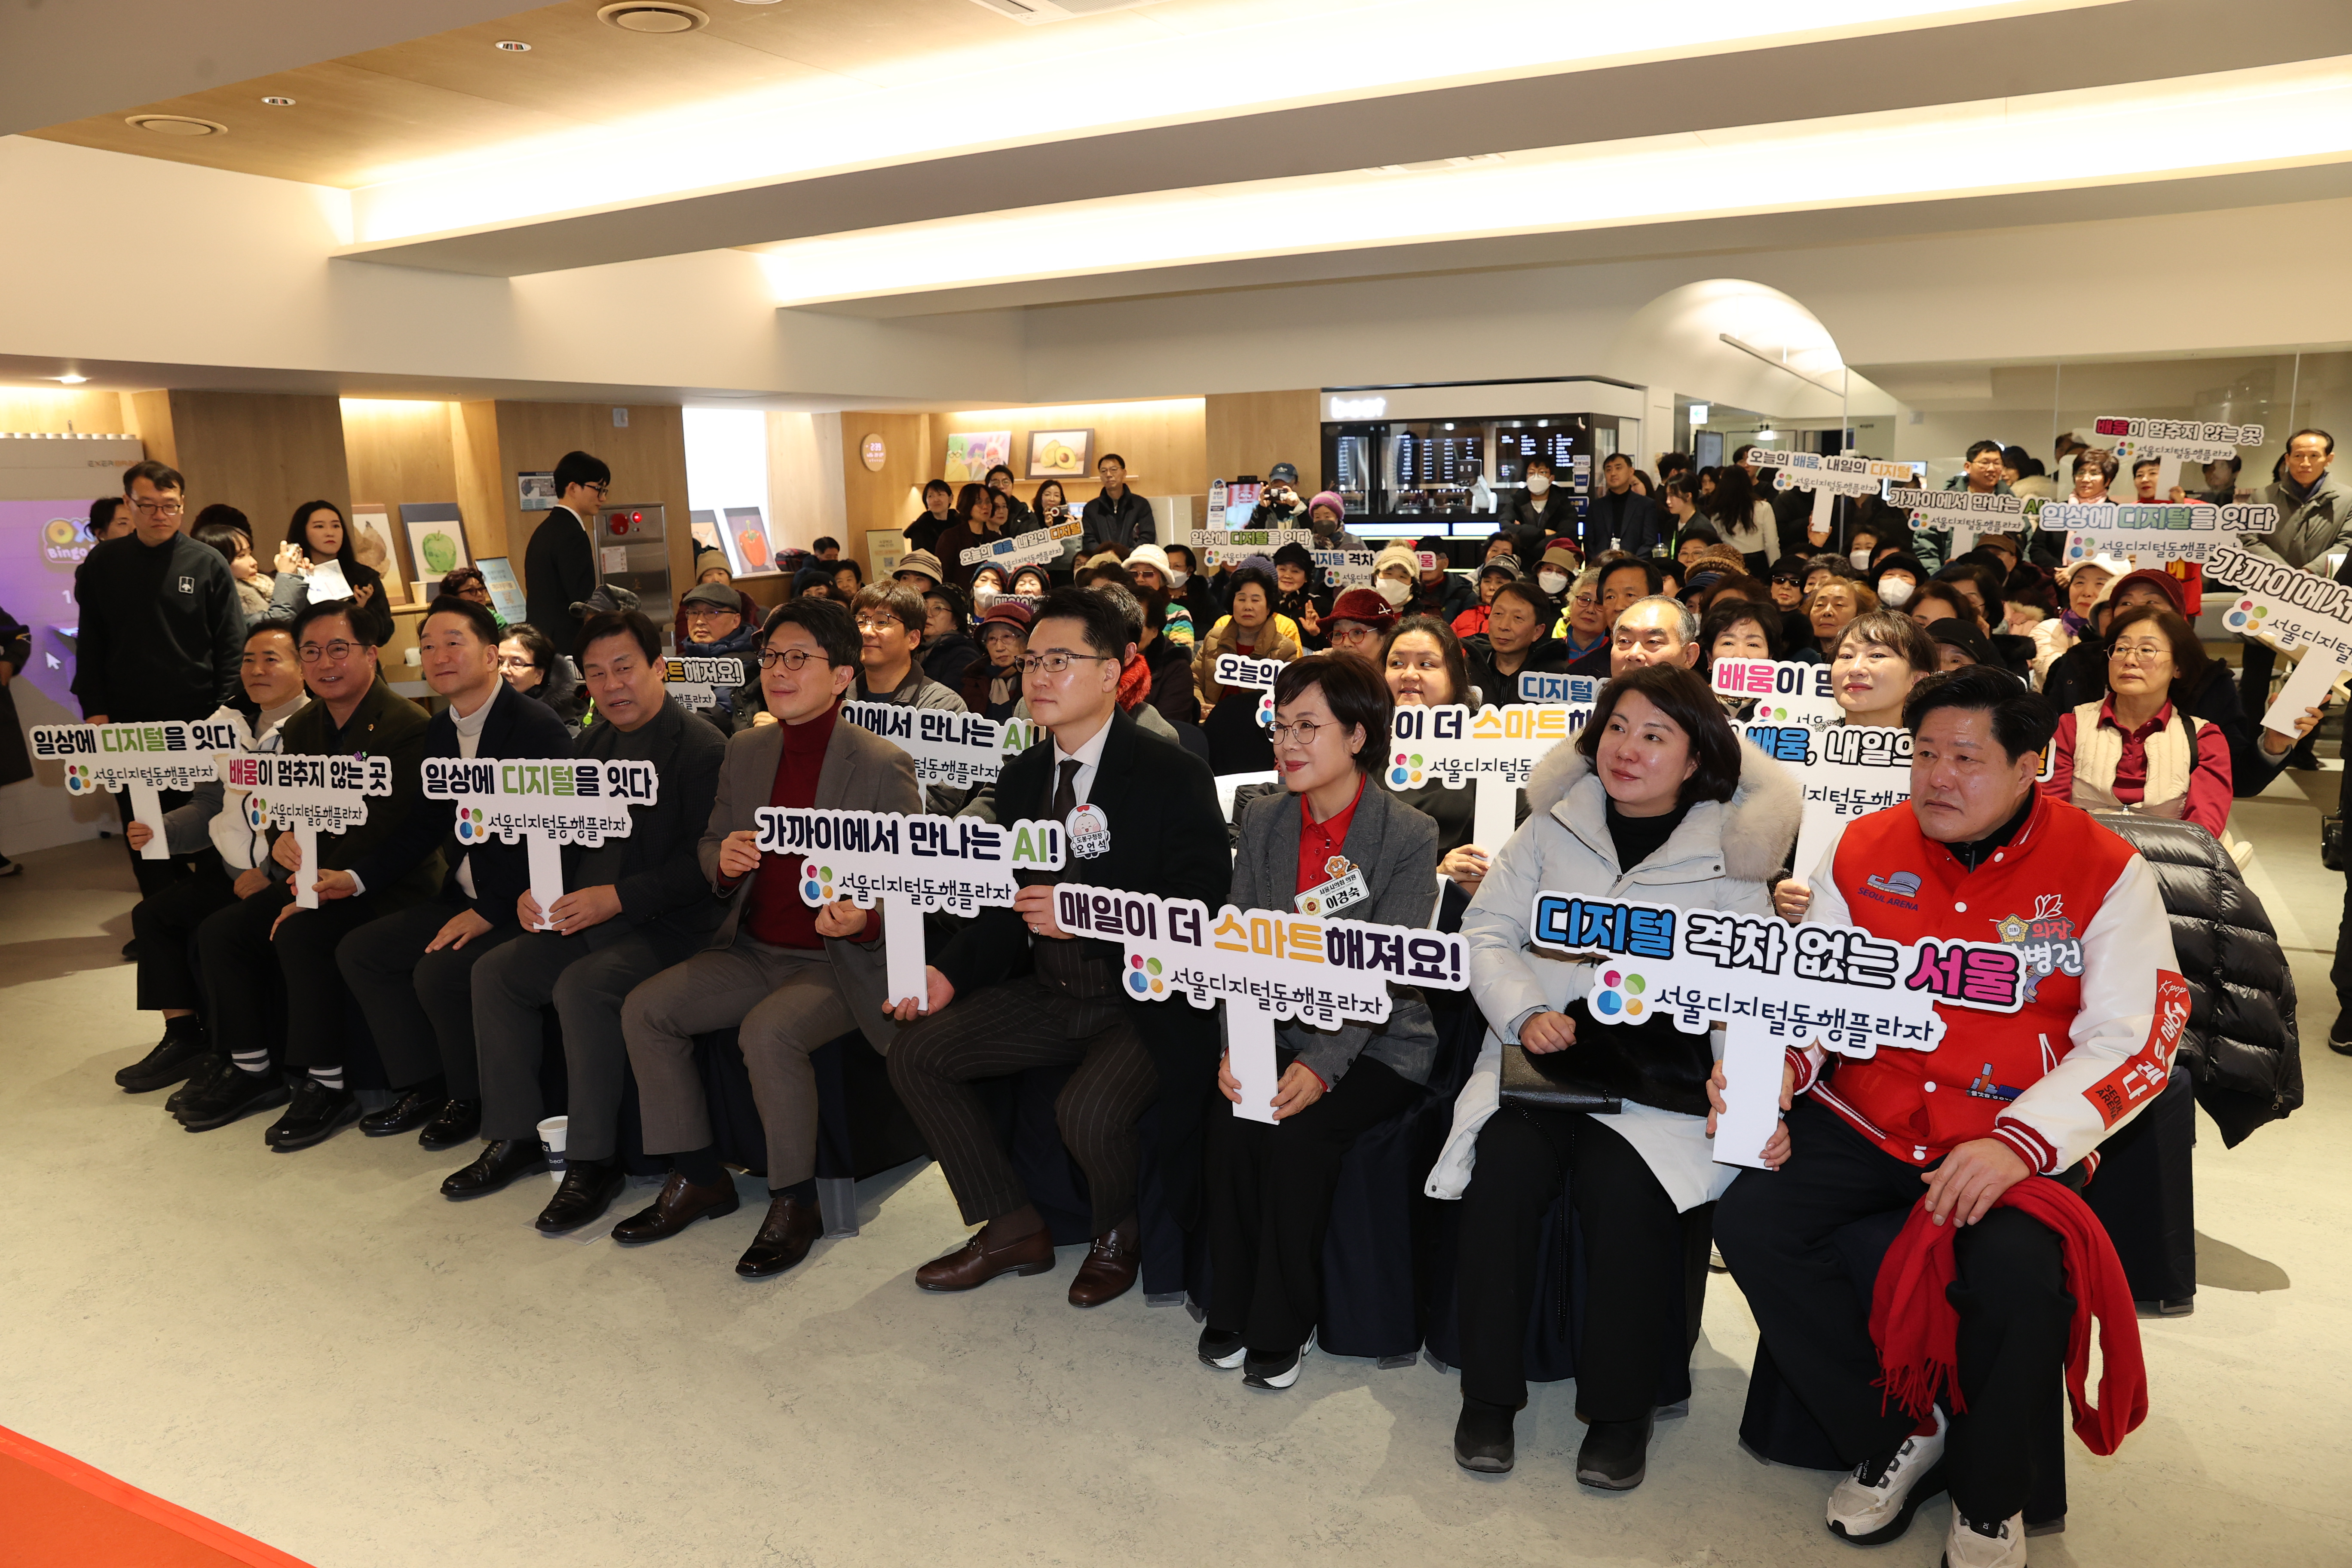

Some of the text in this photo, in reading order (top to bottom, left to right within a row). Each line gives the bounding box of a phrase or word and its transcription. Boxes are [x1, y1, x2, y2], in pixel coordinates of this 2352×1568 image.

[2096, 417, 2262, 444] 배움이 멈추지 않는 곳
[1749, 450, 1911, 479] 오늘의 배움, 내일의 디지털
[2137, 444, 2233, 461] 서울디지털동행플라자
[1795, 478, 1878, 494] 서울디지털동행플라자
[1890, 490, 2050, 515] 가까이에서 만나는 AI
[1931, 517, 2022, 533] 서울디지털동행플라자
[2042, 505, 2275, 531] 일상에 디지털을 잇다
[961, 521, 1082, 563] 오늘의 배움, 내일의 디지털
[1191, 531, 1311, 545] 일상에 디지털을 잇다
[2099, 540, 2238, 559] 서울디지털동행플
[47, 546, 86, 560] Bingo
[1310, 552, 1374, 566] 디지털 격차
[1418, 554, 1433, 567] 울
[2205, 547, 2352, 624] 가까이에서
[1219, 659, 1279, 686] 오늘의
[1718, 663, 1804, 695] 배움이
[1523, 677, 1592, 702] 디지털
[921, 714, 995, 748] 만나는
[1434, 710, 1462, 740] 더
[34, 724, 236, 755] 일상에 디지털을 잇다
[94, 765, 214, 787] 서울디지털동행플라자
[229, 759, 387, 790] 배움이 멈추지 않는 곳
[426, 764, 652, 799] 일상에 디지털을 잇다
[270, 802, 362, 829] 서울디지털동행플라자
[488, 813, 626, 841] 서울디지털동행플라자
[760, 813, 1058, 863] 가까이에서 만나는 AI!
[1077, 833, 1102, 843] 도봉구청장
[839, 873, 1012, 911] 서울디지털동행플라자
[1320, 874, 1357, 895] 서울시의회 의원
[1326, 887, 1360, 909] 이경숙
[1858, 887, 1918, 911] SEOUL ARENA
[1060, 891, 1461, 983] 매일이 더 스마트해져요!
[2032, 920, 2072, 940] 의장
[1536, 896, 2019, 1007] 디지털 격차 없는 서울
[2012, 940, 2082, 973] 병건
[1170, 968, 1383, 1022] 서울디지털동행플라자
[2158, 980, 2187, 998] Kpop
[1654, 986, 1934, 1049] 서울디지털동행플라자
[2095, 1090, 2117, 1121] ARENA
[2104, 1084, 2123, 1115] SEOUL
